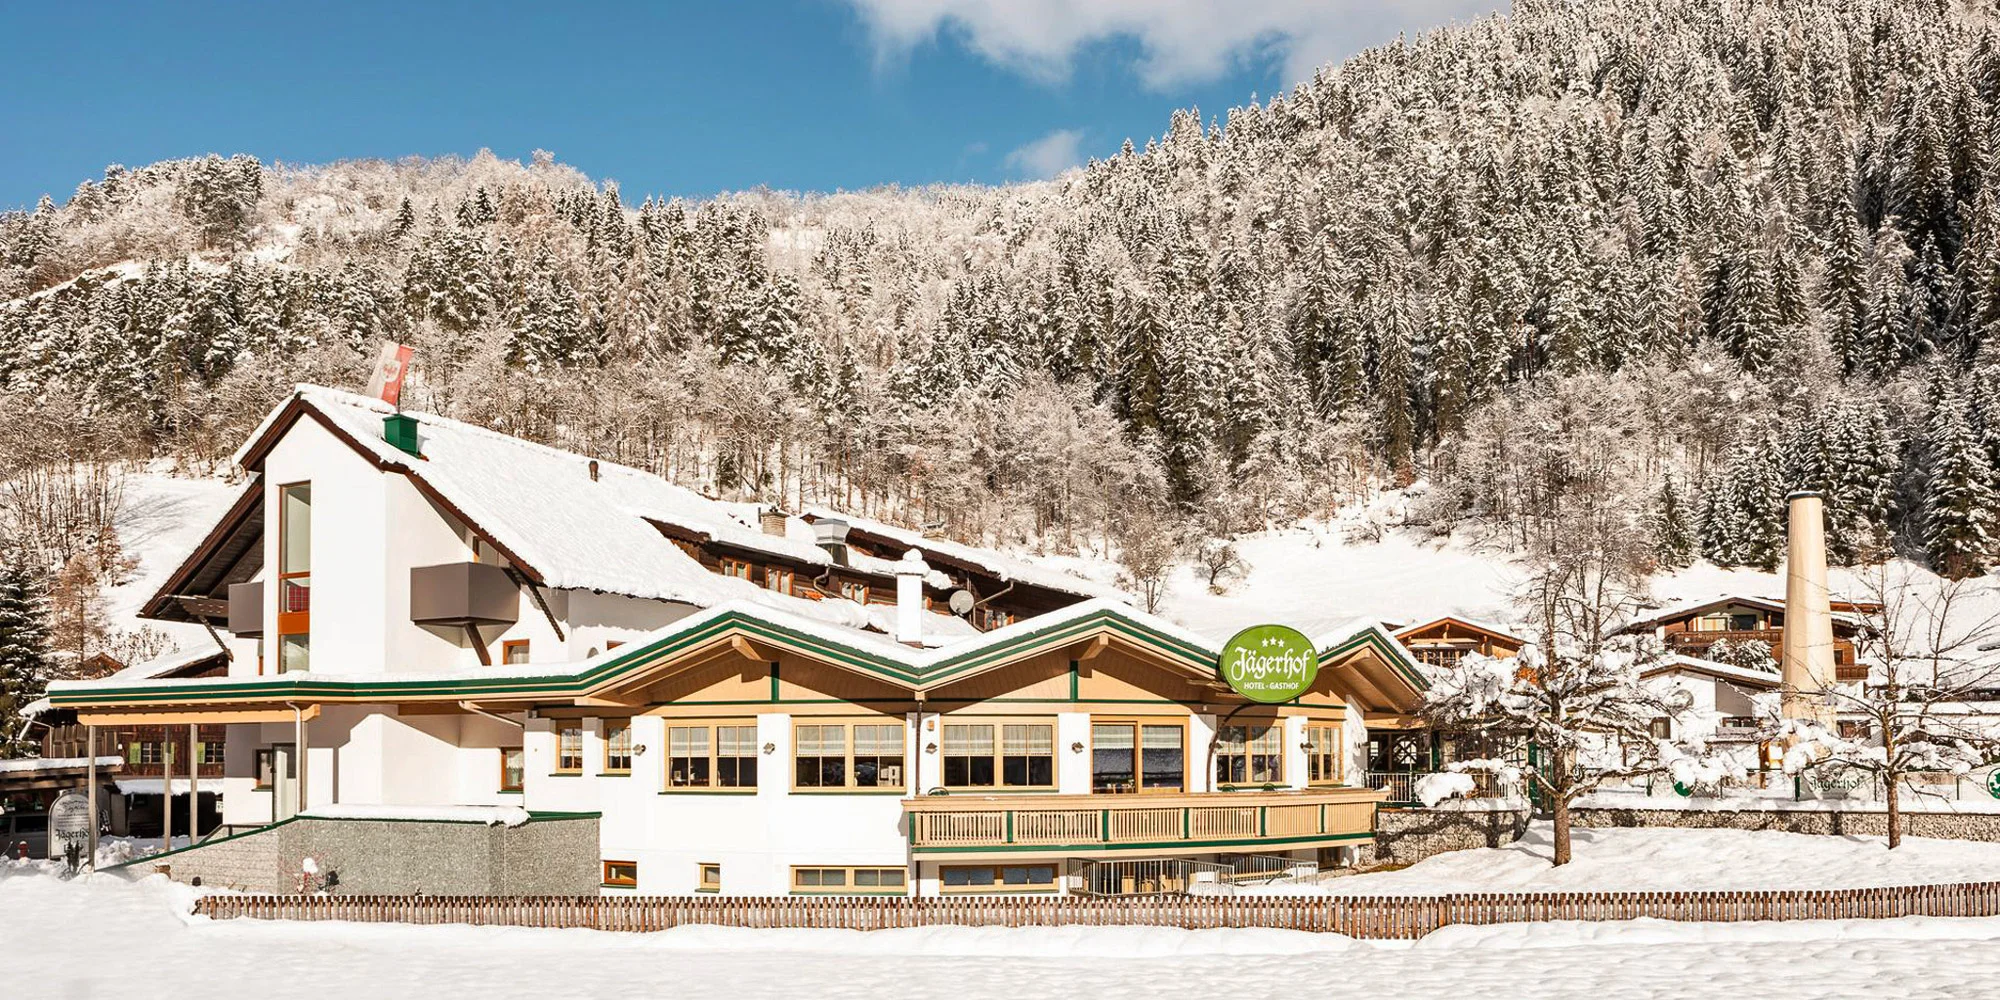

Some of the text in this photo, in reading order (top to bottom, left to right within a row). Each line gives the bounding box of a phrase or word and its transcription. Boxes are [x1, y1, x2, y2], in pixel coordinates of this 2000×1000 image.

[1231, 646, 1313, 682] Jägerhof
[1243, 681, 1300, 690] HOTEL GASTHOF
[55, 827, 90, 841] Jägerho
